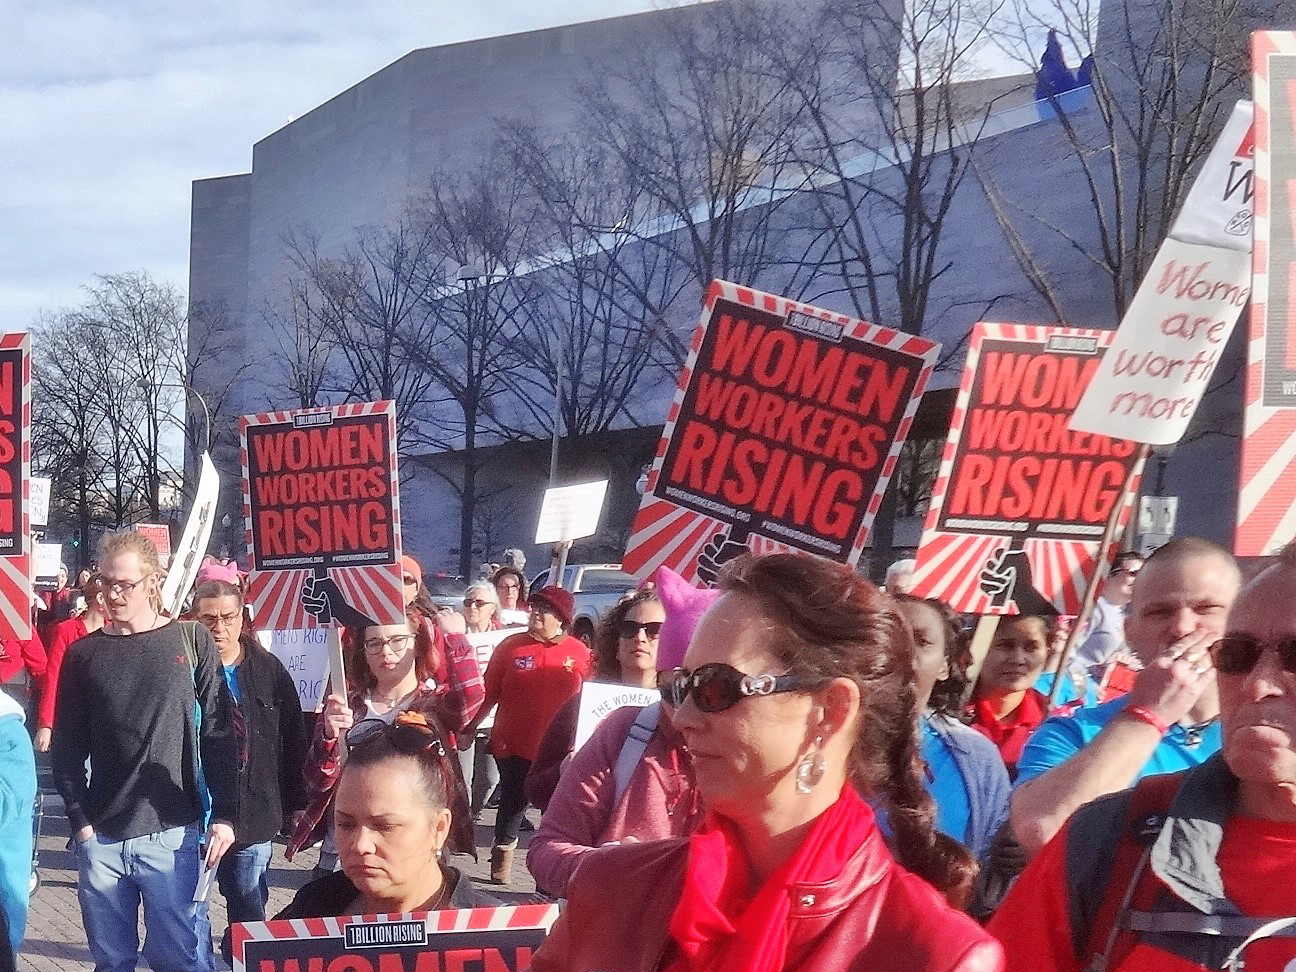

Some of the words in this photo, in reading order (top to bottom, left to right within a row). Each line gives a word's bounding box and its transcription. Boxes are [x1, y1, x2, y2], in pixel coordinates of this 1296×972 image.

[1156, 258, 1252, 308] Wome
[1161, 312, 1227, 343] are
[711, 314, 909, 423] WOMEN
[981, 352, 1102, 408] WOM
[694, 372, 887, 470] WORKERS
[1109, 389, 1195, 420] more
[255, 423, 385, 473] WOMEN
[257, 466, 387, 507] WORKERS
[670, 420, 864, 539] RISING
[949, 455, 1126, 522] RISING
[259, 501, 388, 556] RISING
[288, 655, 307, 671] ARE
[591, 700, 612, 718] THE
[613, 693, 652, 706] WOMEN
[393, 923, 422, 942] RISING
